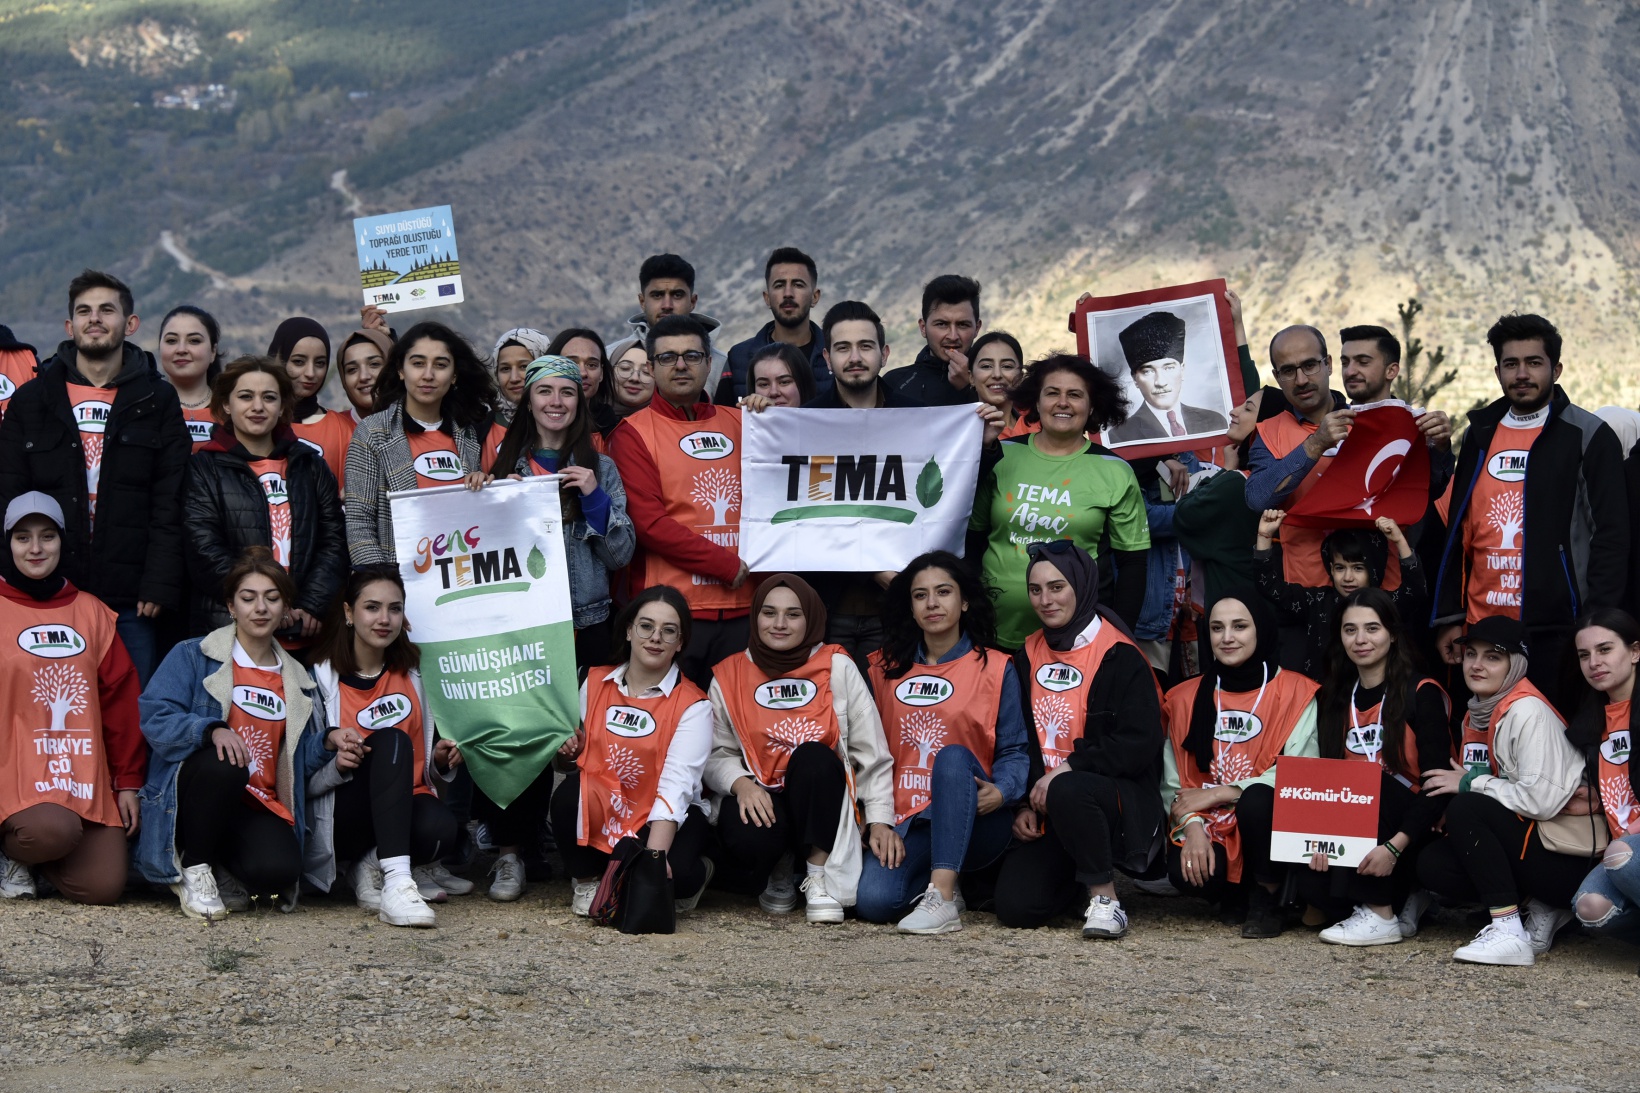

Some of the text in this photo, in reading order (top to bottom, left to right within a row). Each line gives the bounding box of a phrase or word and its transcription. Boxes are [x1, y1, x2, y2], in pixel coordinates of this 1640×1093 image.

[375, 216, 432, 236] SUYU DÜŞTÜĞÜ
[369, 228, 442, 249] TOPRAĞI OLUŞTUĞU
[386, 244, 429, 259] YERDE TUT!
[373, 293, 395, 303] TEMA
[689, 436, 720, 450] TEMA
[424, 456, 455, 469] TEMA
[1498, 456, 1525, 470] TEMA
[782, 454, 907, 502] TEMA
[1017, 483, 1072, 507] TEMA
[1009, 502, 1069, 535] Ağaç
[413, 525, 481, 574] genç
[434, 546, 523, 590] TEMA
[1486, 552, 1522, 570] TÜRKİ
[1500, 571, 1521, 590] ÇÖL
[1486, 590, 1522, 607] OLMAS
[31, 631, 70, 644] TEMA
[438, 641, 546, 674] GÜMÜŞHANE
[440, 664, 552, 700] ÜNİVERSİTESİ
[1047, 667, 1070, 681] TEMA
[767, 684, 799, 698] TEMA
[908, 682, 939, 696] TEMA
[243, 688, 275, 709] TEMA
[367, 700, 398, 720] TEMA
[612, 709, 640, 727] TEMA
[1279, 786, 1374, 805] #KömürÜzer
[1304, 840, 1336, 854] TEMA
